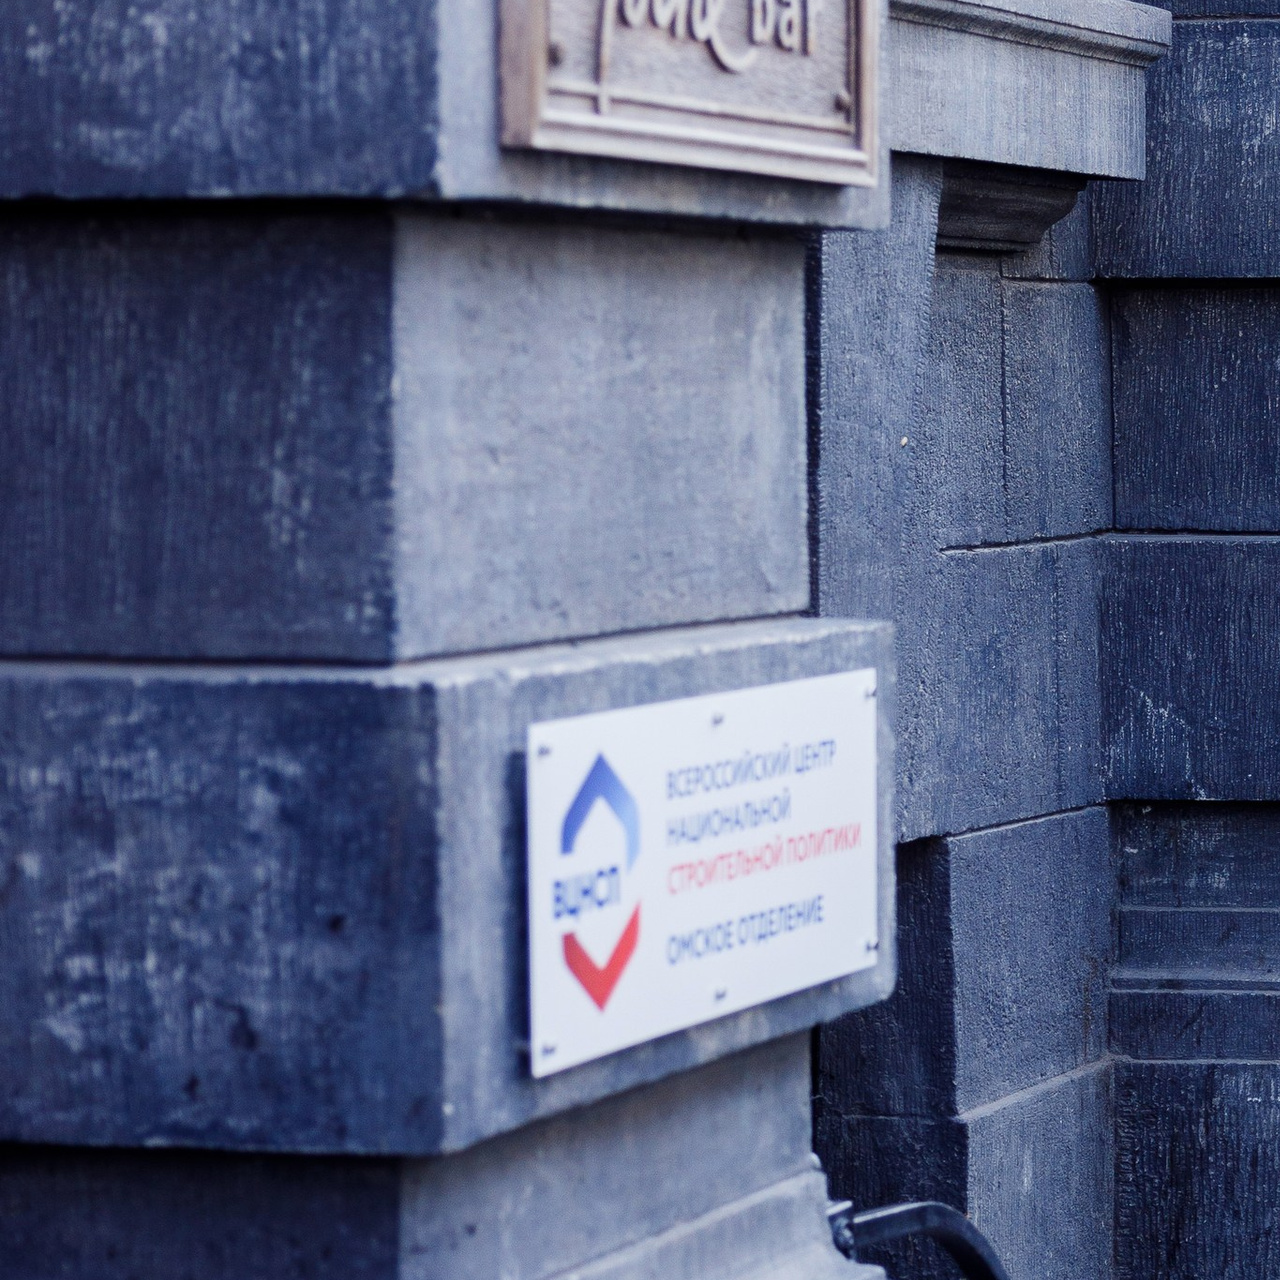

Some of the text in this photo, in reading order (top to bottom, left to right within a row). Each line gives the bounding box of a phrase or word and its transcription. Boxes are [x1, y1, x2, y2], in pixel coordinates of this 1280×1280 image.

[666, 739, 837, 800] ВСЕРОССИЙСКИЙ ЦЕНТР
[666, 787, 793, 847] НАЦИОНАЛЬНОЙ
[667, 822, 862, 896] СТРОИТЕЛЬНОЙ ПОЛИТИКИ
[666, 894, 826, 966] ОМСКОЕ ОТДЕЛЕНИЕ
